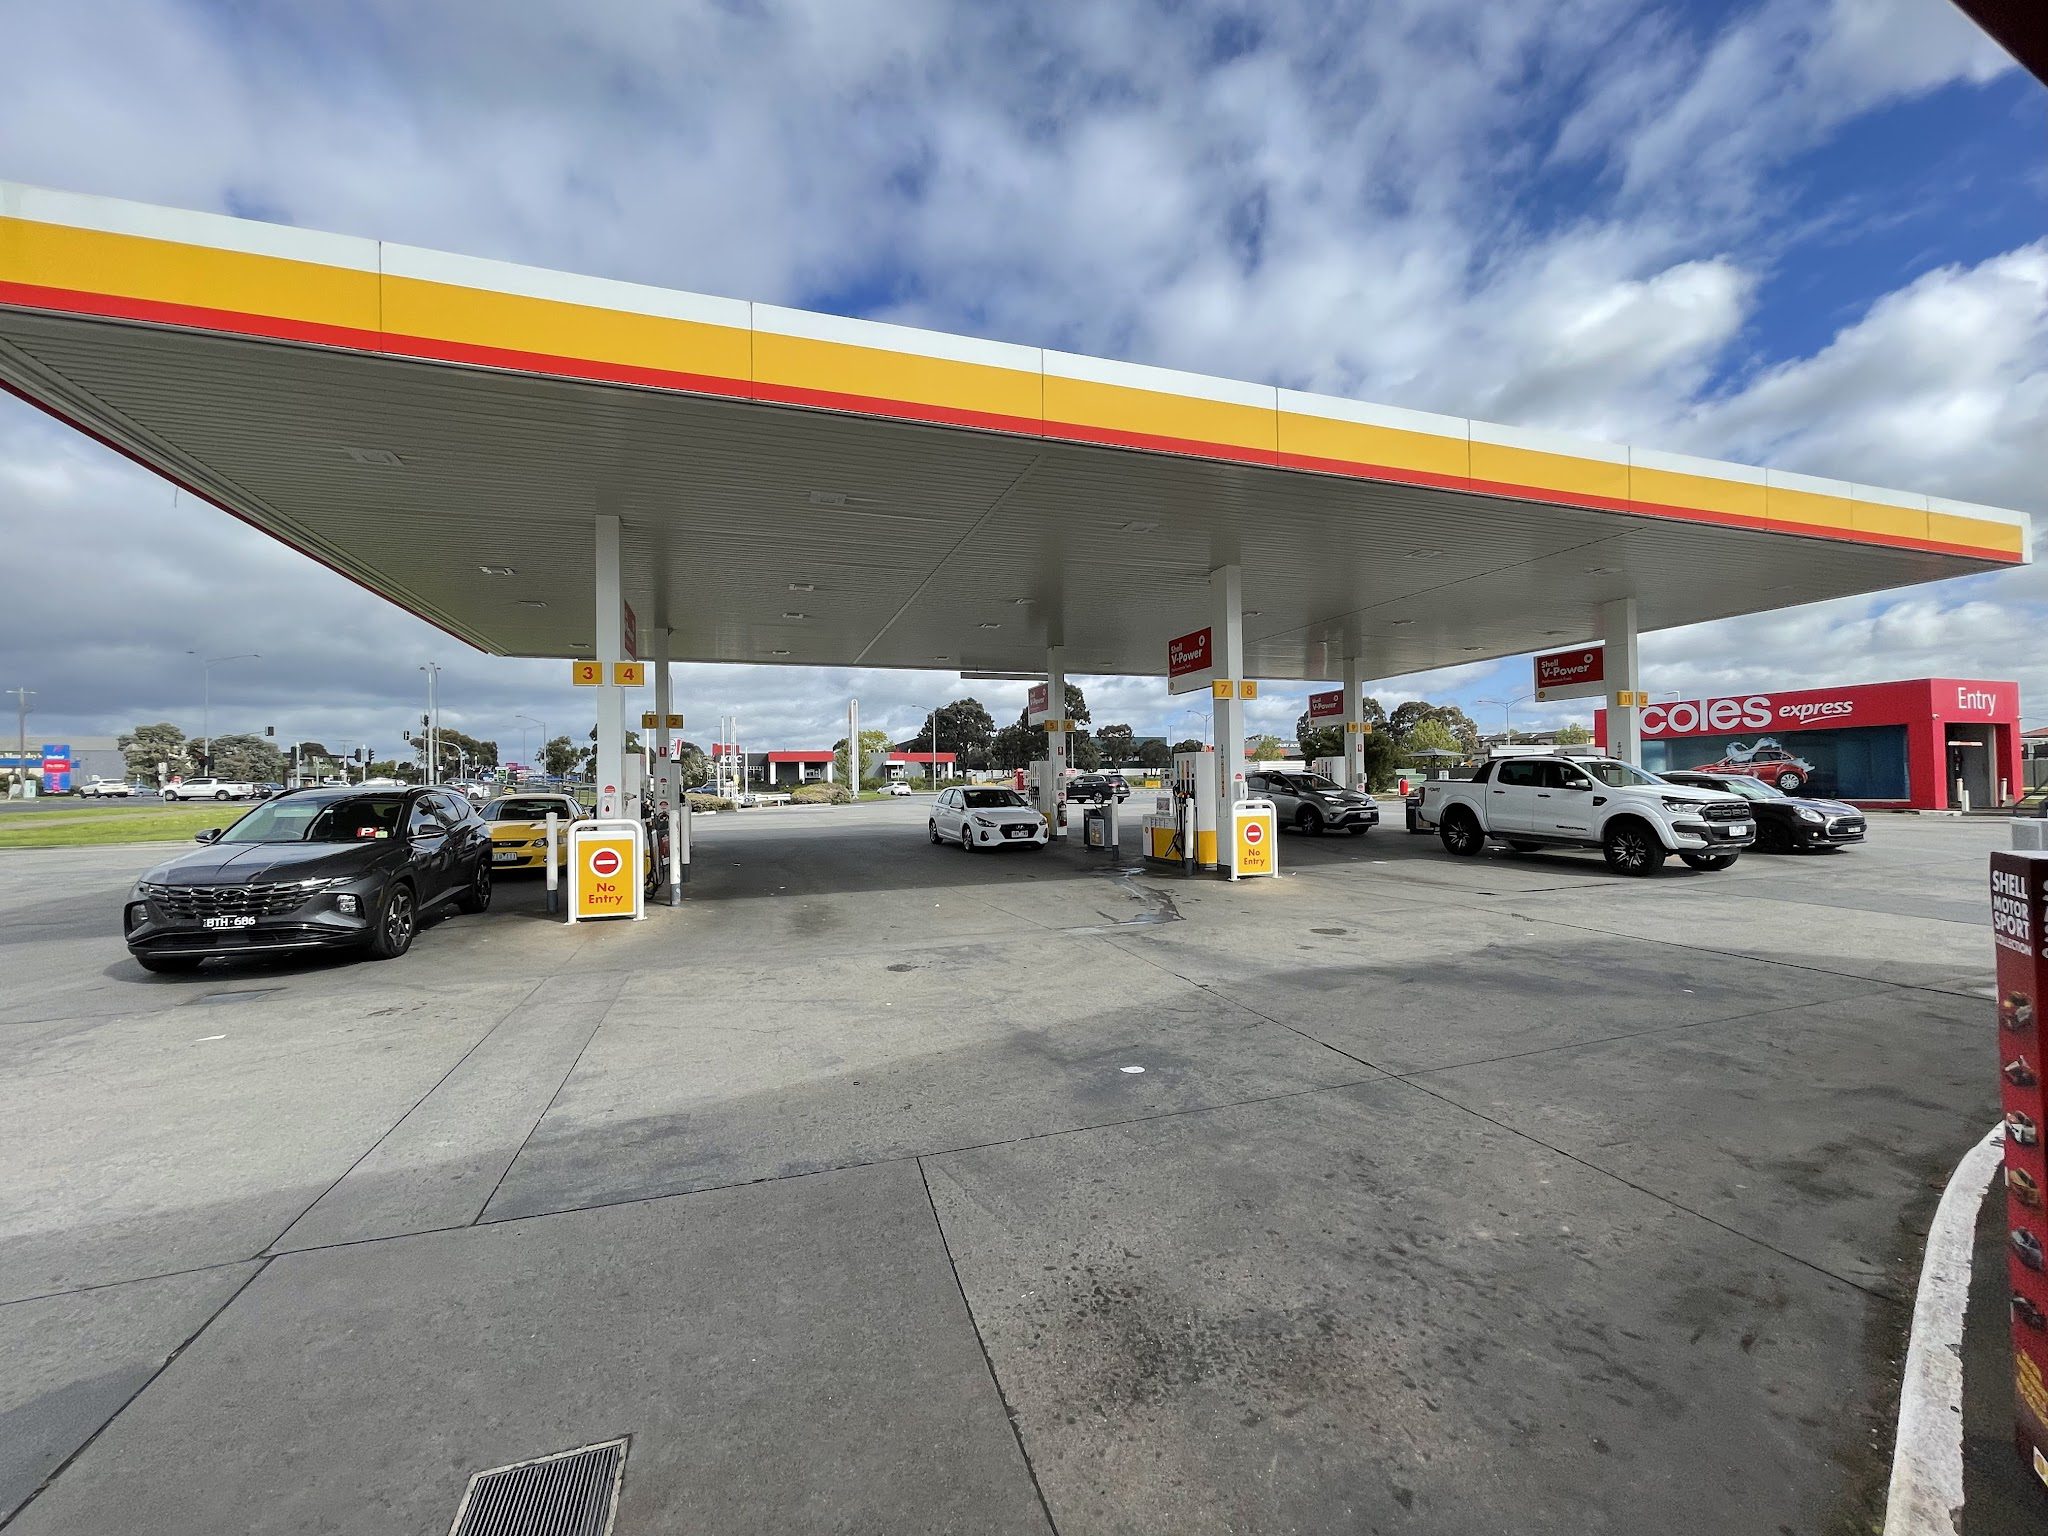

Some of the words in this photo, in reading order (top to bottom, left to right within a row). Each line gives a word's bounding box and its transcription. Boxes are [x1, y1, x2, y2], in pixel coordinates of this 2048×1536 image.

[1171, 643, 1182, 654] Shell
[1171, 648, 1202, 665] V-Power
[1541, 659, 1559, 669] Shell
[583, 667, 593, 679] 3
[623, 668, 634, 680] 4
[1542, 664, 1589, 678] V-Power
[1220, 684, 1227, 694] 7
[1246, 684, 1253, 695] 8
[1623, 694, 1631, 704] 11
[1958, 687, 1996, 716] Entry
[1639, 696, 1772, 735] coles
[1778, 700, 1854, 719] express
[361, 827, 374, 836] P
[1248, 849, 1260, 857] No
[1243, 857, 1265, 867] Entry
[596, 882, 616, 893] No
[1992, 870, 2028, 900] SHELL
[588, 894, 623, 906] Entry
[1993, 895, 2029, 921] MOTOR
[1994, 910, 2031, 940] SPORT
